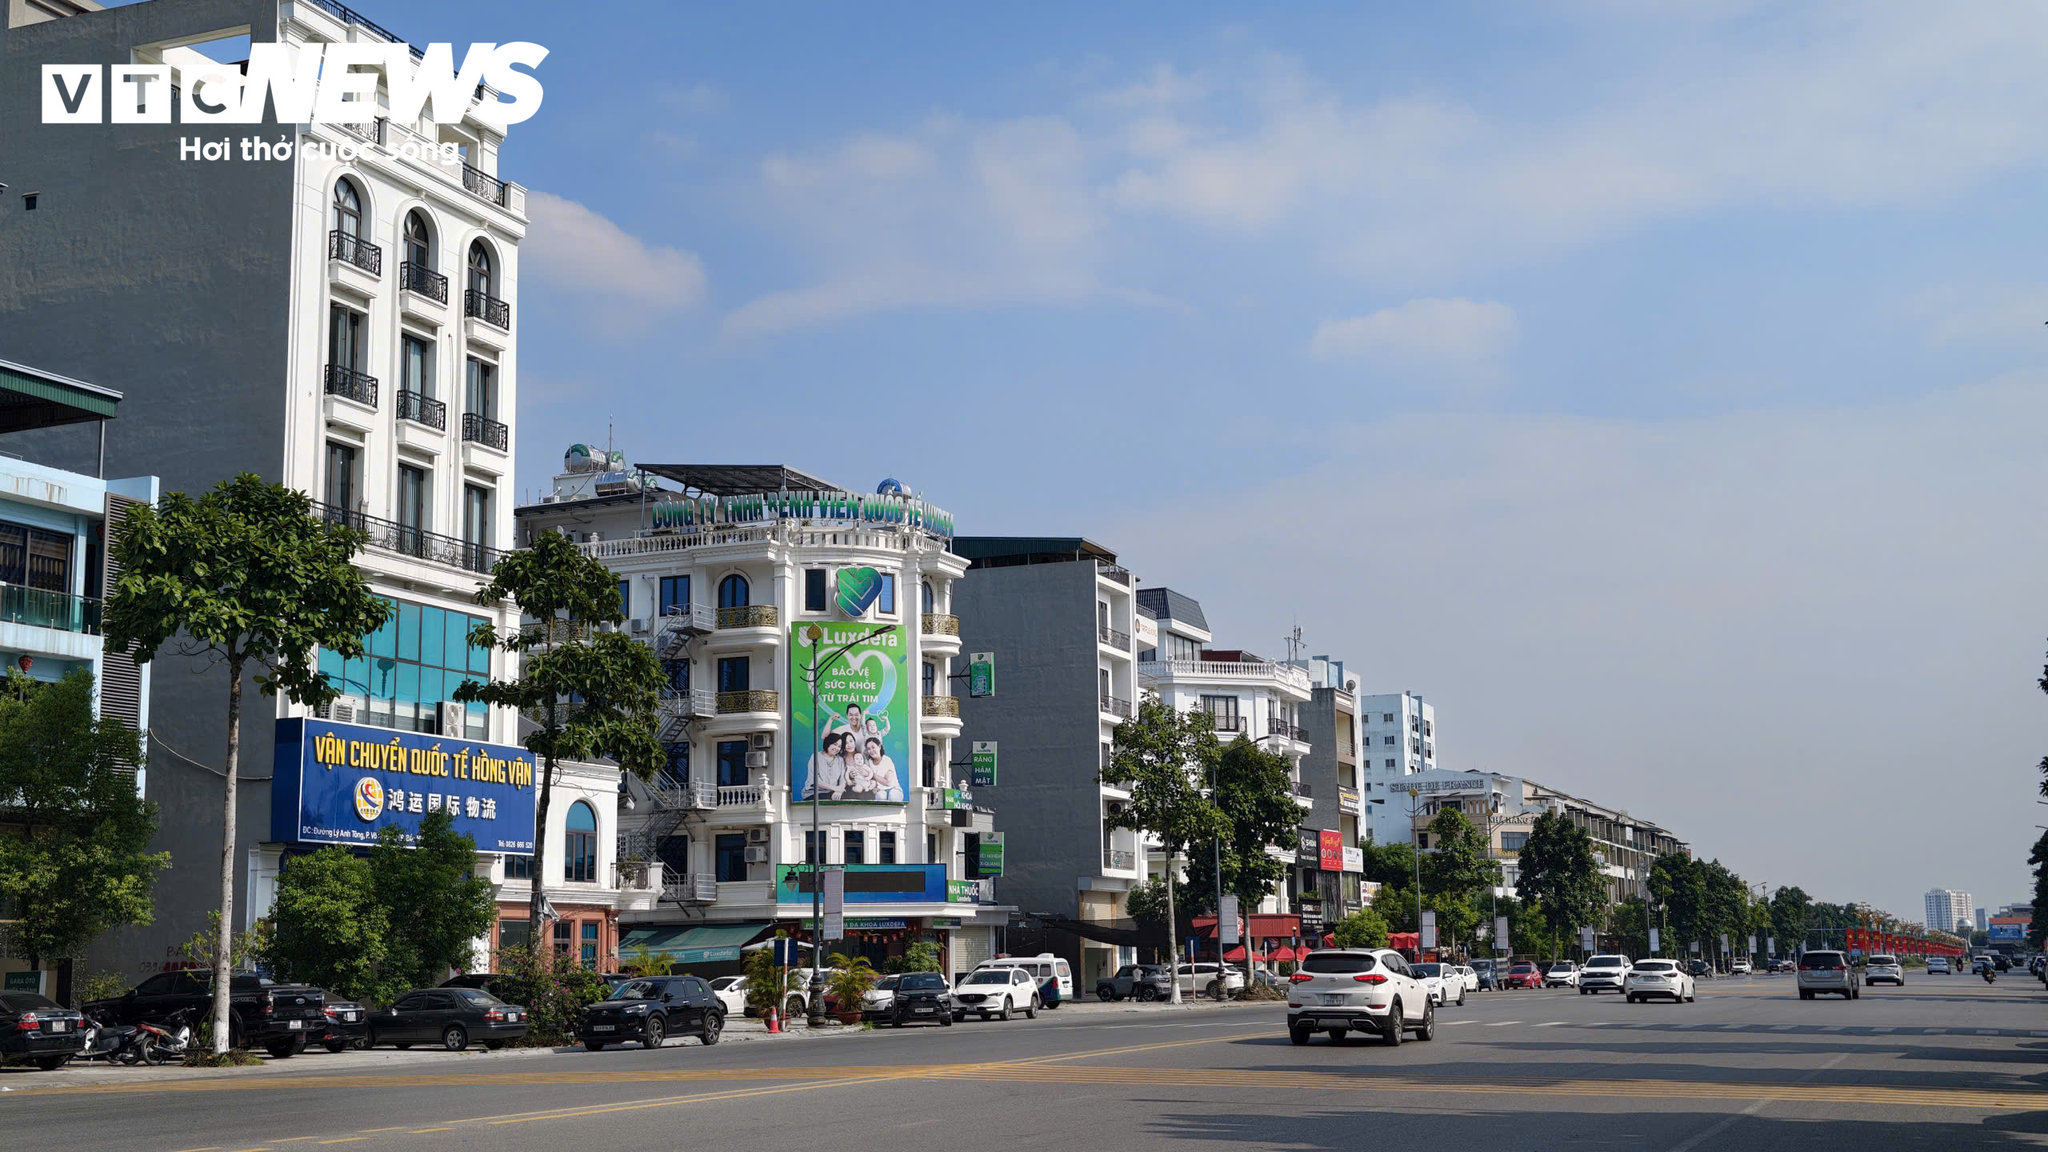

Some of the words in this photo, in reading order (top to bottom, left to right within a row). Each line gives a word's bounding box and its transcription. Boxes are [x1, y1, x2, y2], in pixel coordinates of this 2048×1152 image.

[698, 495, 718, 524] TY
[832, 665, 855, 676] BẢO
[858, 666, 870, 678] VỆ
[825, 679, 846, 689] SỨC
[849, 679, 876, 690] KHỎE
[837, 692, 859, 702] TRÁI
[862, 694, 878, 702] TIM
[315, 731, 346, 770] VẬN
[350, 736, 407, 772] CHUYỂN
[410, 743, 449, 777] QUỐC
[453, 746, 470, 779] TẾ
[472, 748, 506, 783] HỒNG
[508, 756, 532, 790] VẬN
[1441, 778, 1484, 791] FRANCE
